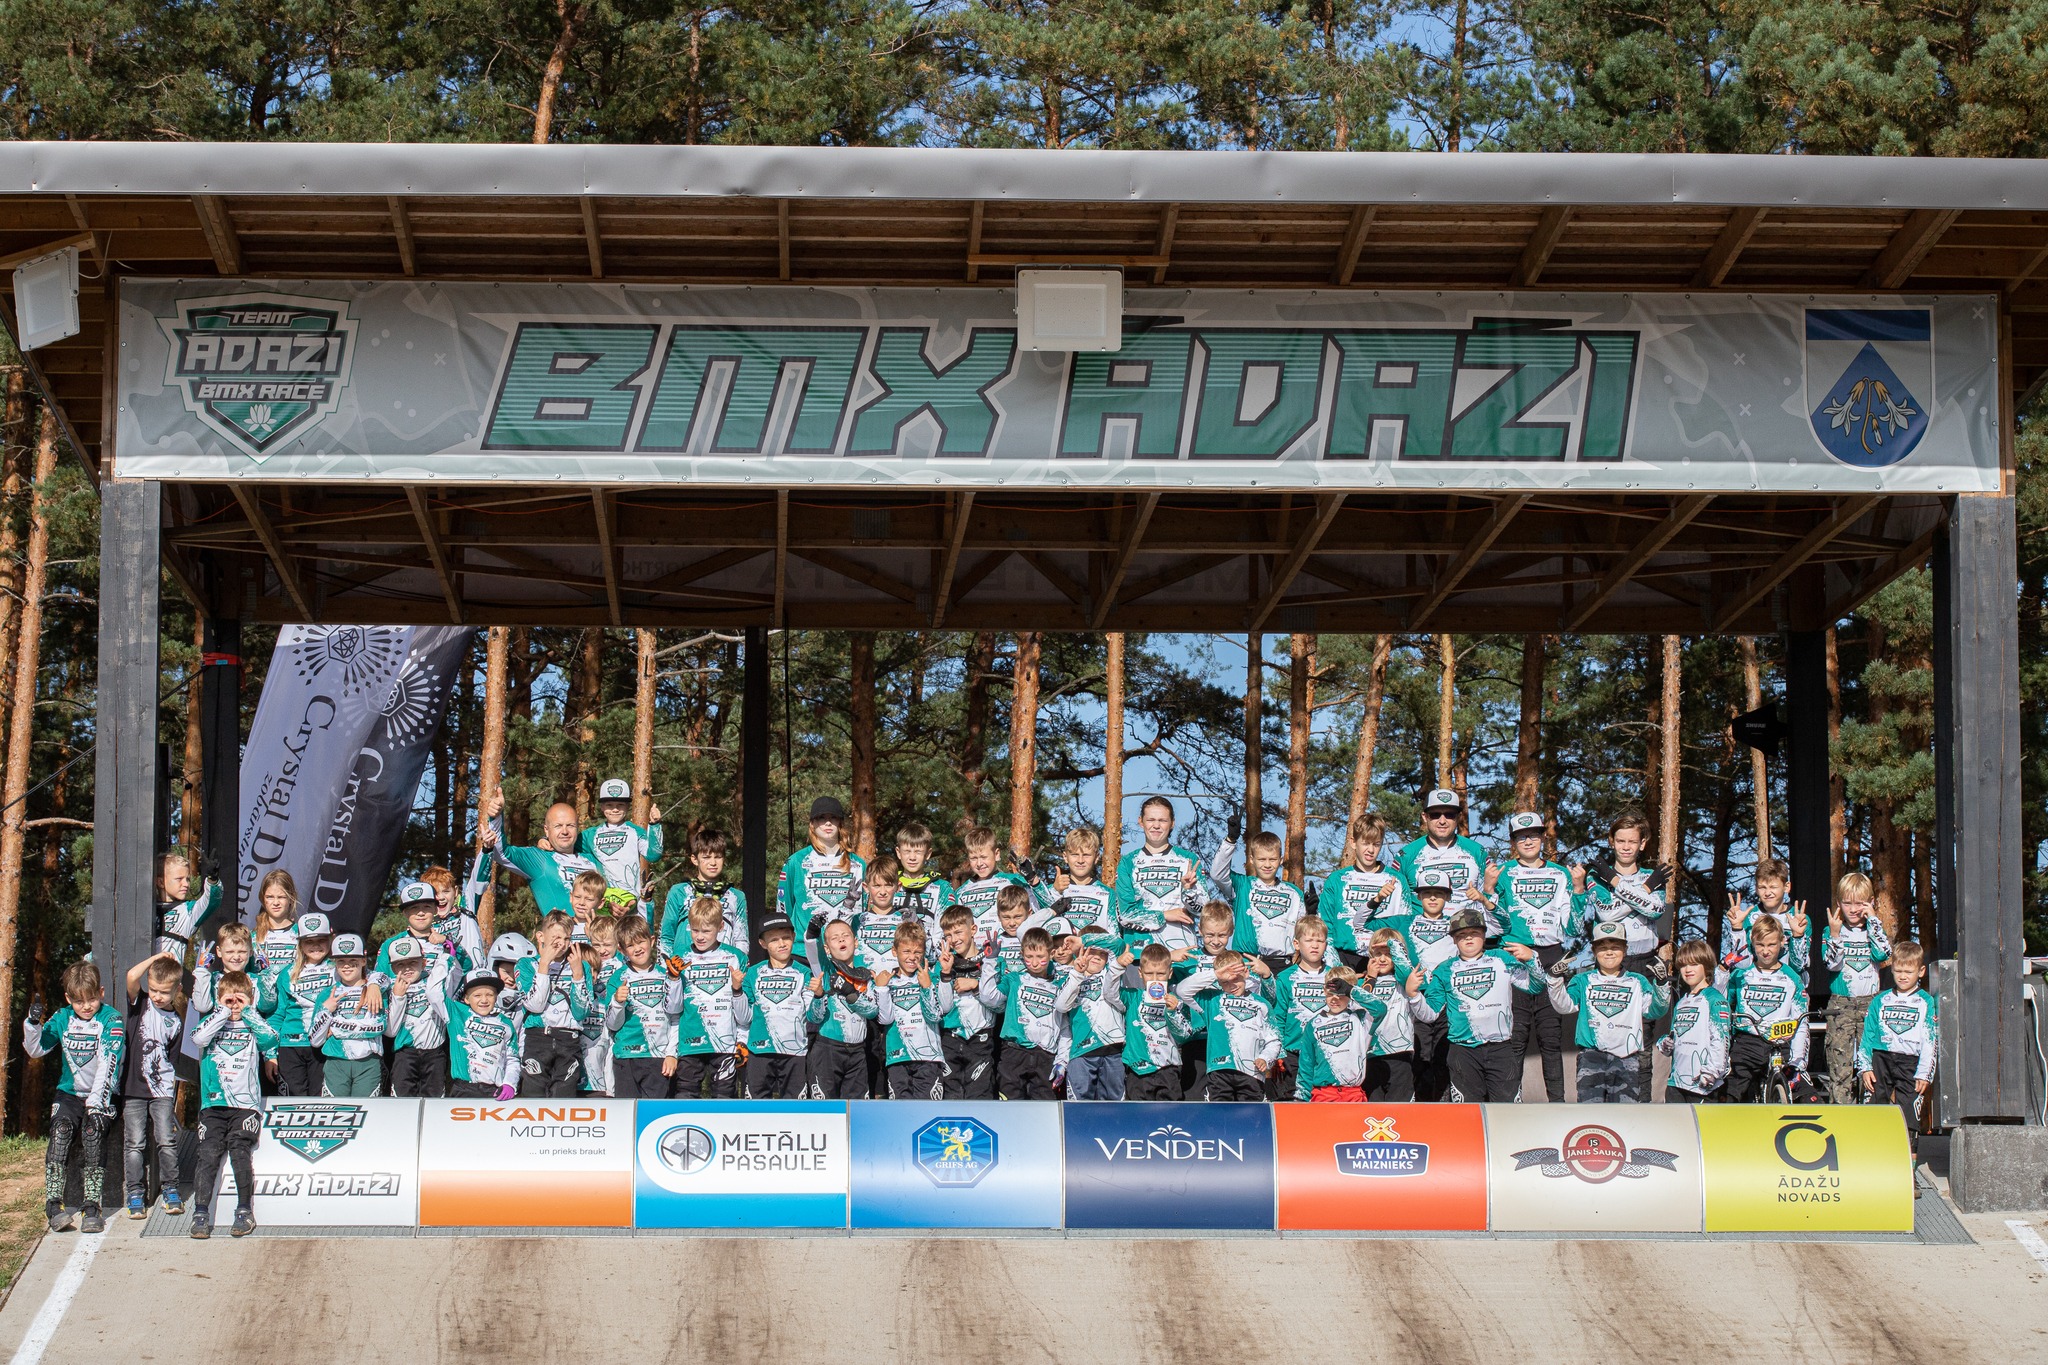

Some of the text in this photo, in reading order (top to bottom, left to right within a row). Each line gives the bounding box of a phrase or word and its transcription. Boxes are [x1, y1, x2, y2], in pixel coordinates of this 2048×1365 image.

[229, 311, 292, 324] TEAM
[198, 384, 326, 399] BMX RACE
[480, 321, 1018, 458] BMX
[264, 694, 337, 821] Crystal
[1138, 871, 1181, 880] ADAZI
[810, 879, 850, 887] ADAZ
[1517, 884, 1557, 893] ADAZI
[1252, 894, 1290, 906] ADAZI
[862, 930, 895, 938] ADAZ
[690, 970, 729, 979] ADAZI
[1454, 972, 1495, 985] ADAZI
[759, 981, 796, 989] ADAZI
[1021, 992, 1054, 1004] ADAZ
[1589, 990, 1632, 1001] ADAZI
[1746, 991, 1785, 1000] ADAZI
[1884, 1012, 1919, 1020] ADAZI
[1317, 1023, 1352, 1036] ADAZI
[1774, 1023, 1793, 1035] 808
[450, 1107, 607, 1121] SKANDI
[510, 1125, 606, 1138] MOTORS
[722, 1131, 827, 1151] METĀLU
[1589, 1139, 1599, 1147] JS
[552, 1147, 578, 1158] prieks
[579, 1147, 606, 1155] braukt
[1094, 1137, 1244, 1162] VENDEN
[1346, 1148, 1419, 1160] LATVIJAS
[1593, 1148, 1624, 1158] SAUKA
[722, 1154, 827, 1171] PASAULE
[935, 1161, 978, 1169] GRIFS AG
[1352, 1161, 1414, 1170] MAIZNIEKS
[1778, 1175, 1840, 1188] ĀDAŽU
[1778, 1192, 1840, 1202] NOVADS
